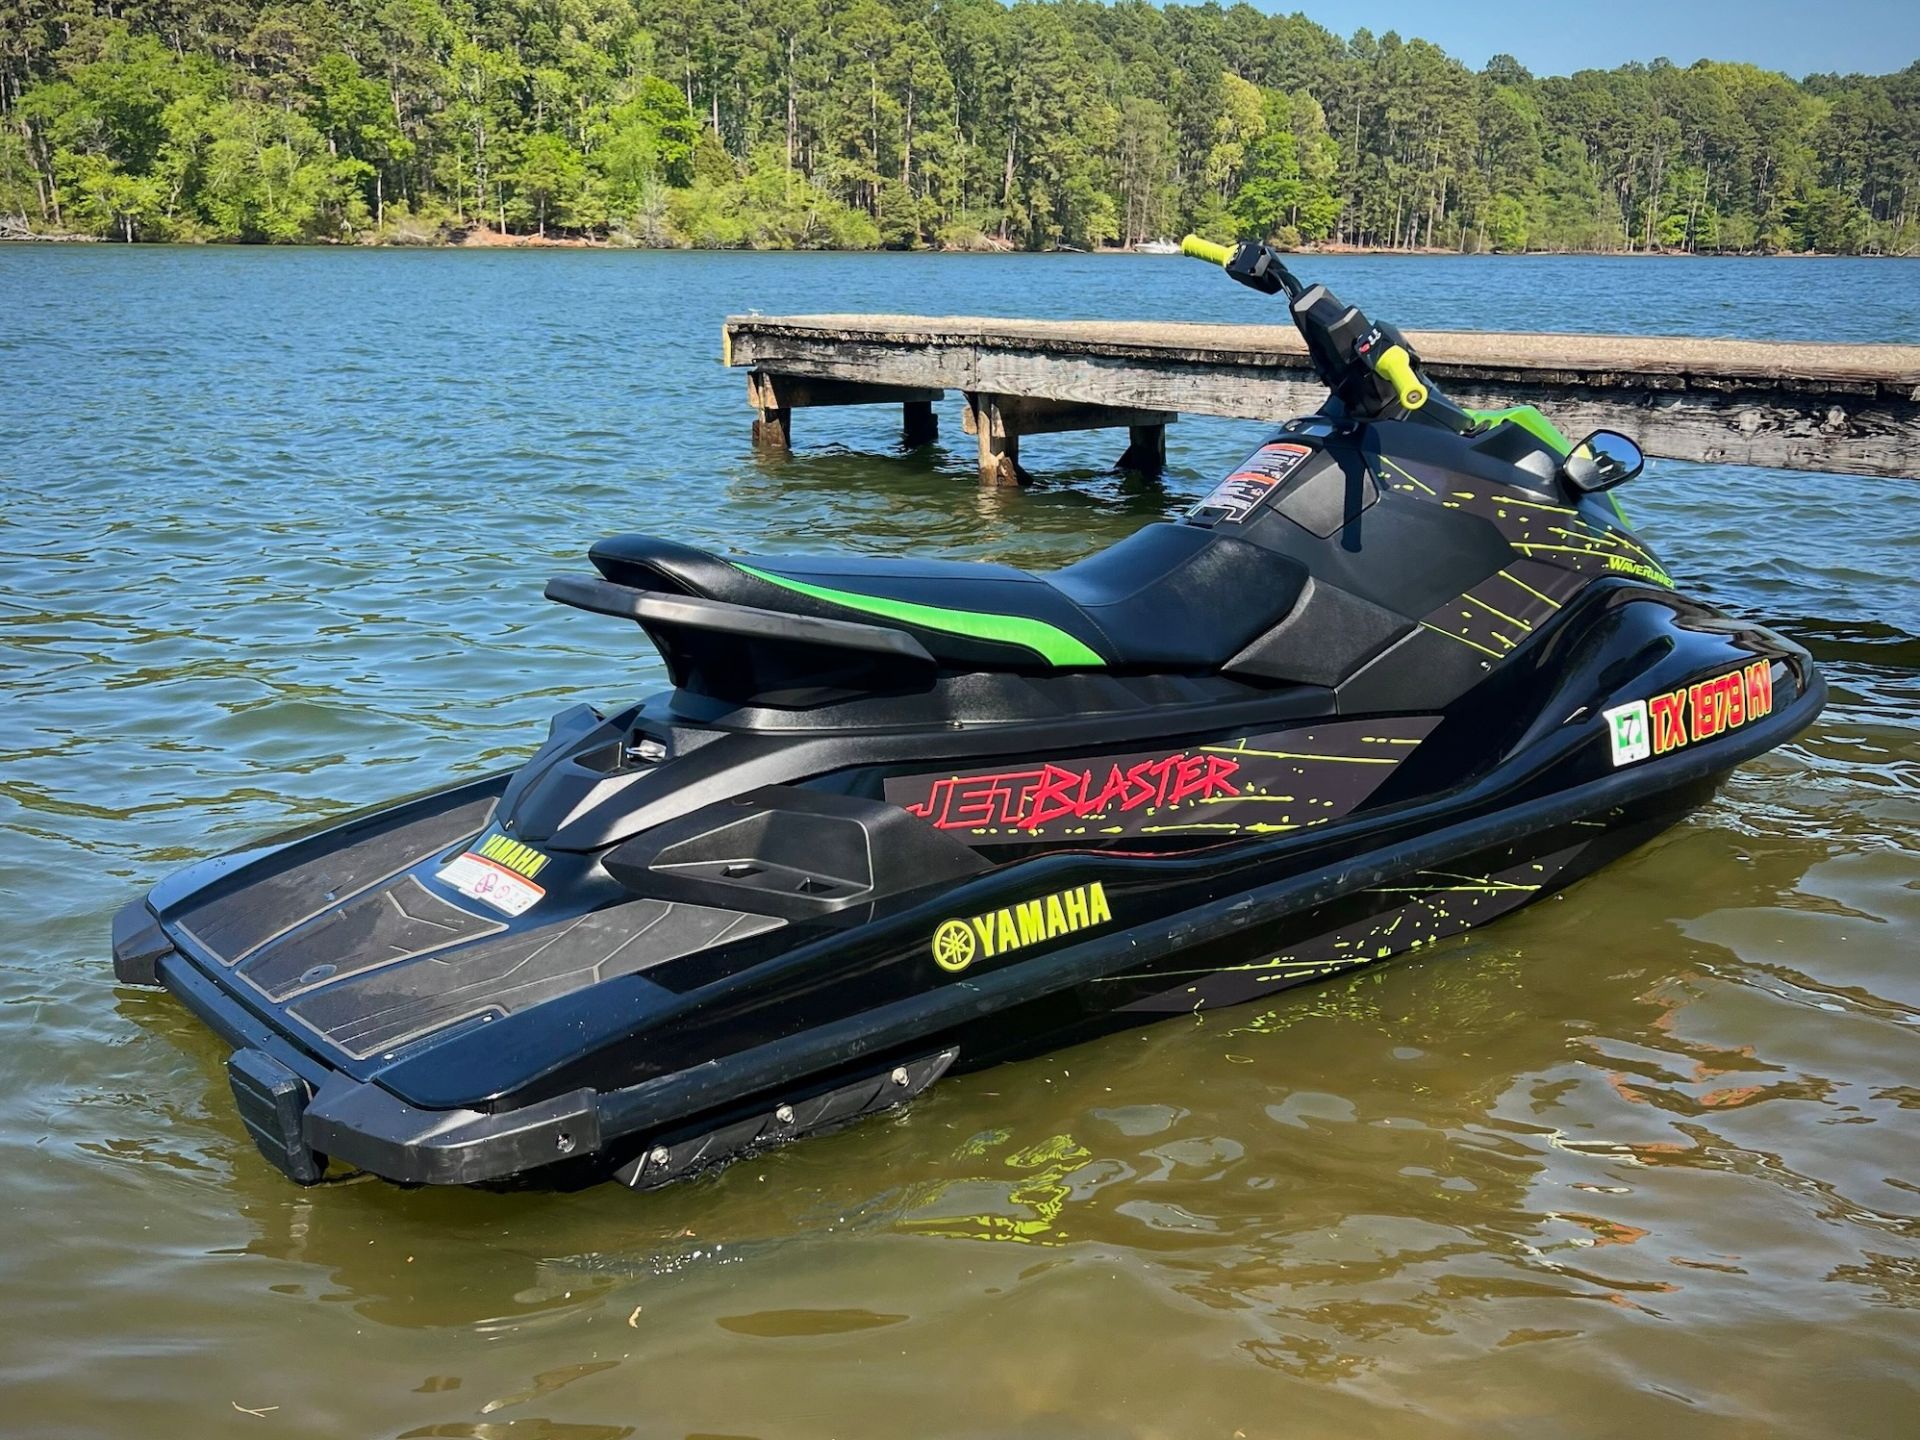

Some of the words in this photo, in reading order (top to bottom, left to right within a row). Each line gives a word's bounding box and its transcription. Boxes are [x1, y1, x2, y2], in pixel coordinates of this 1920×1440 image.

[1649, 688, 1687, 754] TX
[1689, 670, 1746, 740] 1979
[478, 833, 547, 879] YAMAHA
[972, 881, 1112, 958] YAMAHA
